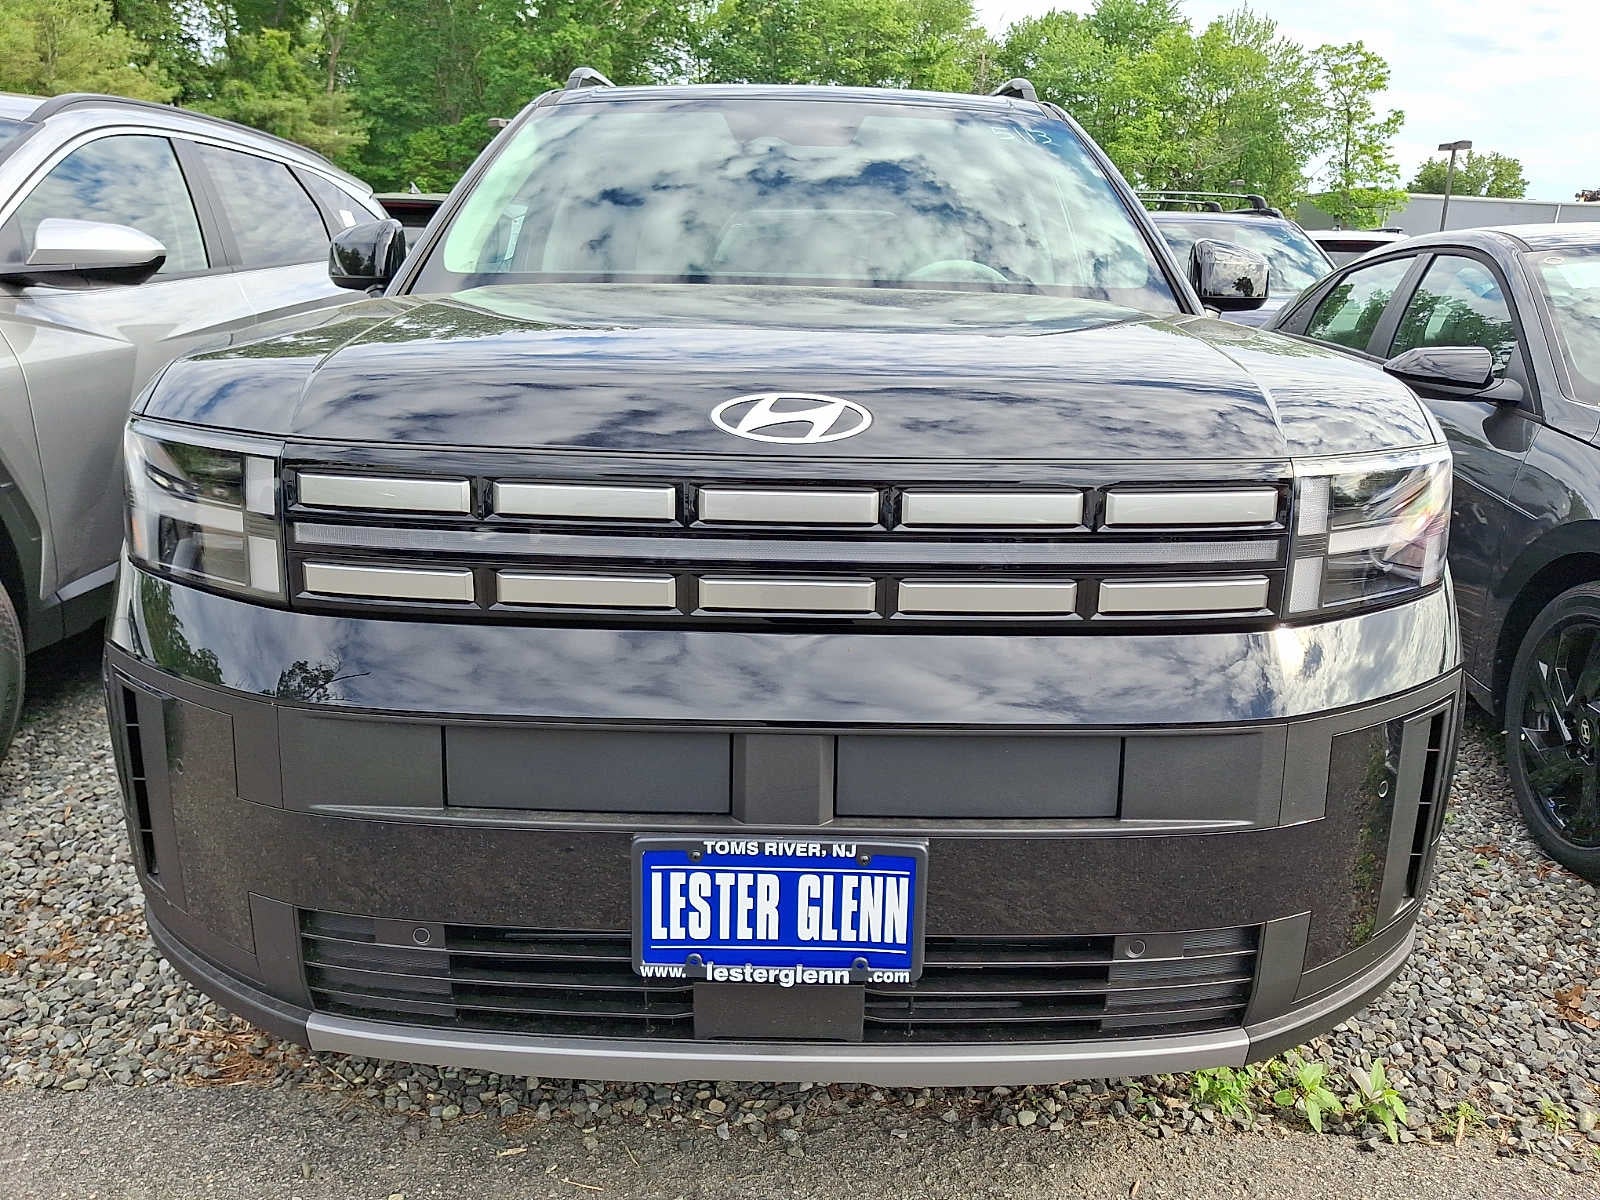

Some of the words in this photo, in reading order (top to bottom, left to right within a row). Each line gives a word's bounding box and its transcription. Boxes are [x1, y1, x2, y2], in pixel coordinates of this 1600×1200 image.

[703, 840, 759, 856] TOMS
[765, 841, 827, 858] RIVER,
[832, 842, 857, 858] NJ
[651, 871, 780, 941] LESTER
[797, 873, 910, 945] GLENN
[640, 964, 687, 978] www.
[706, 961, 850, 988] lesterglenn
[867, 969, 911, 984] .com
